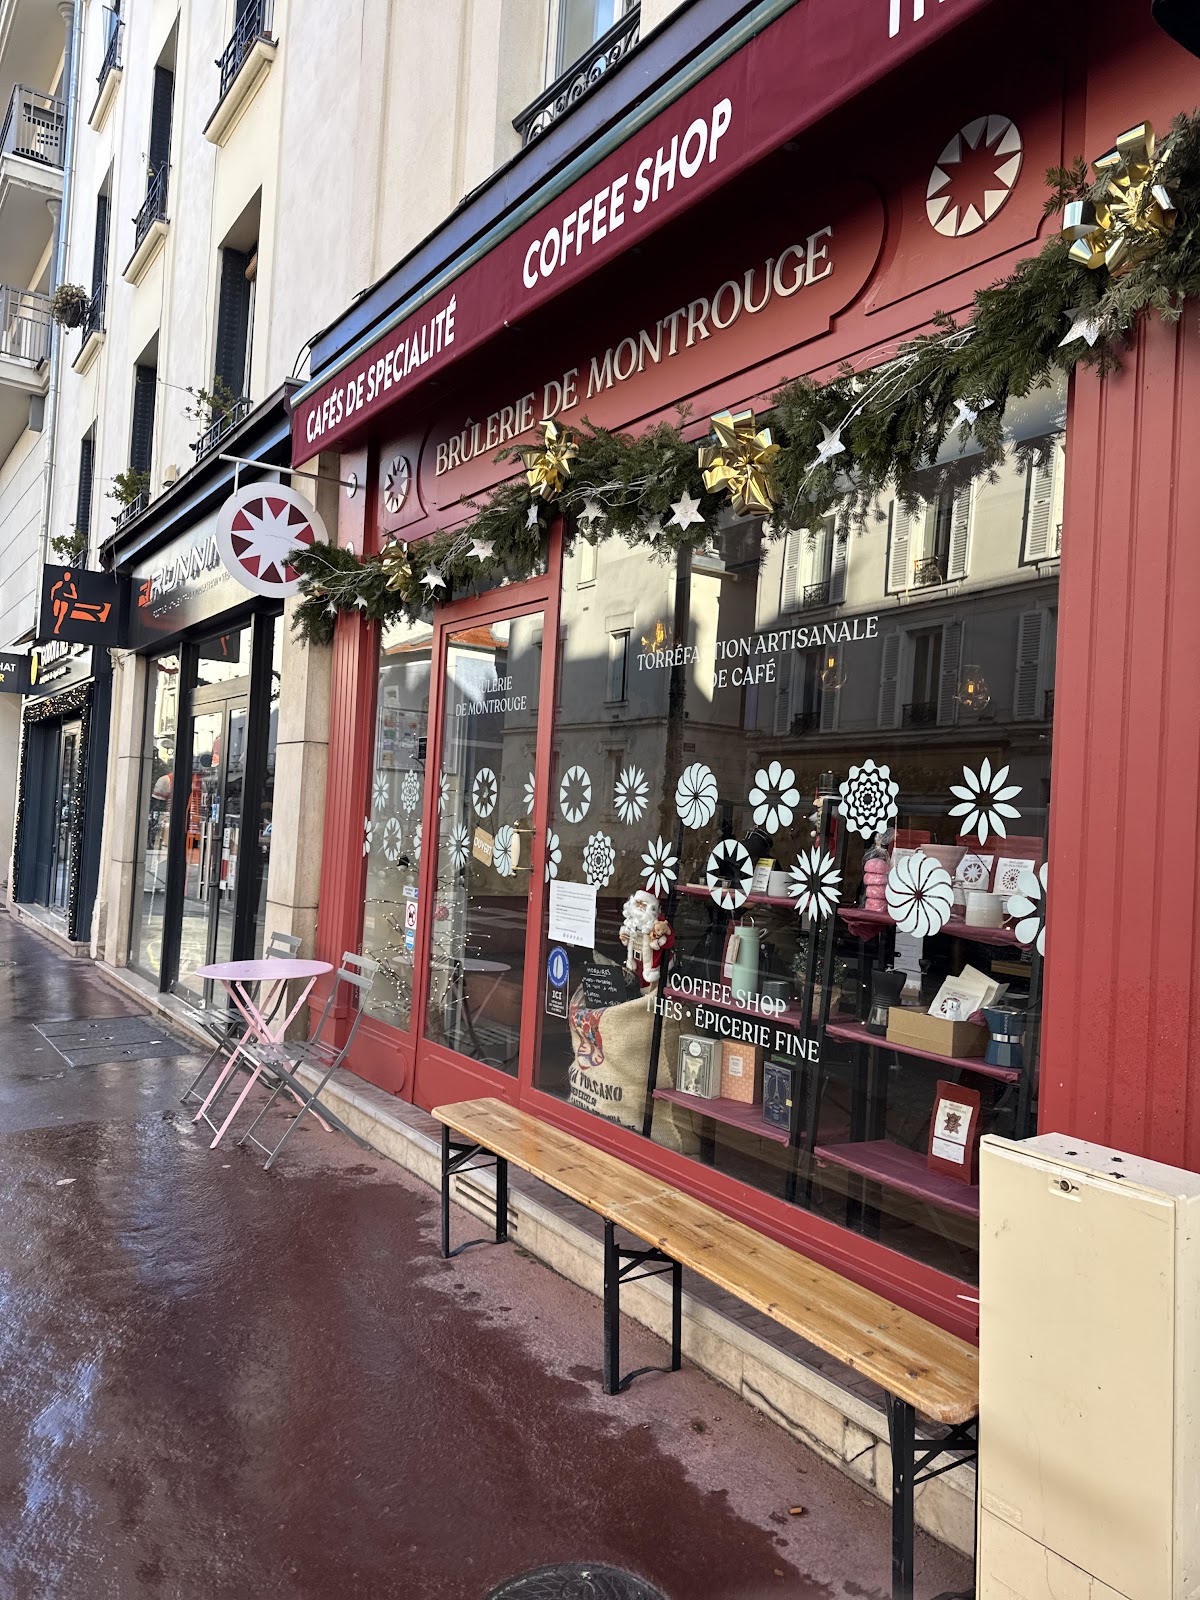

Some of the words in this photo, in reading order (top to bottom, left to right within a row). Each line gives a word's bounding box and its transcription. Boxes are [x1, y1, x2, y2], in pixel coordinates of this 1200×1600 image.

[522, 172, 629, 289] COFFEE
[632, 97, 732, 214] SHOP
[306, 386, 344, 444] CAFÉS
[345, 371, 365, 418] DE
[366, 293, 457, 402] SPECIALITÉ
[435, 391, 536, 477] BRÛLERIE
[542, 367, 580, 421] DE
[586, 225, 833, 399] MONTROUGE
[636, 636, 752, 671] TORRÉFATION
[754, 615, 879, 655] ARTISANALE
[731, 657, 776, 687] CAFÉ
[455, 702, 467, 717] DE
[467, 695, 527, 716] MONTROUGE
[473, 836, 493, 856] OUVERT
[551, 989, 563, 1000] ICI
[670, 972, 732, 1006] COFFEE
[735, 988, 787, 1019] SHOP
[644, 993, 683, 1022] THÉS
[694, 1003, 771, 1048] ÉPICERIE
[774, 1030, 820, 1063] FINE
[579, 1071, 623, 1102] VOLCANO
